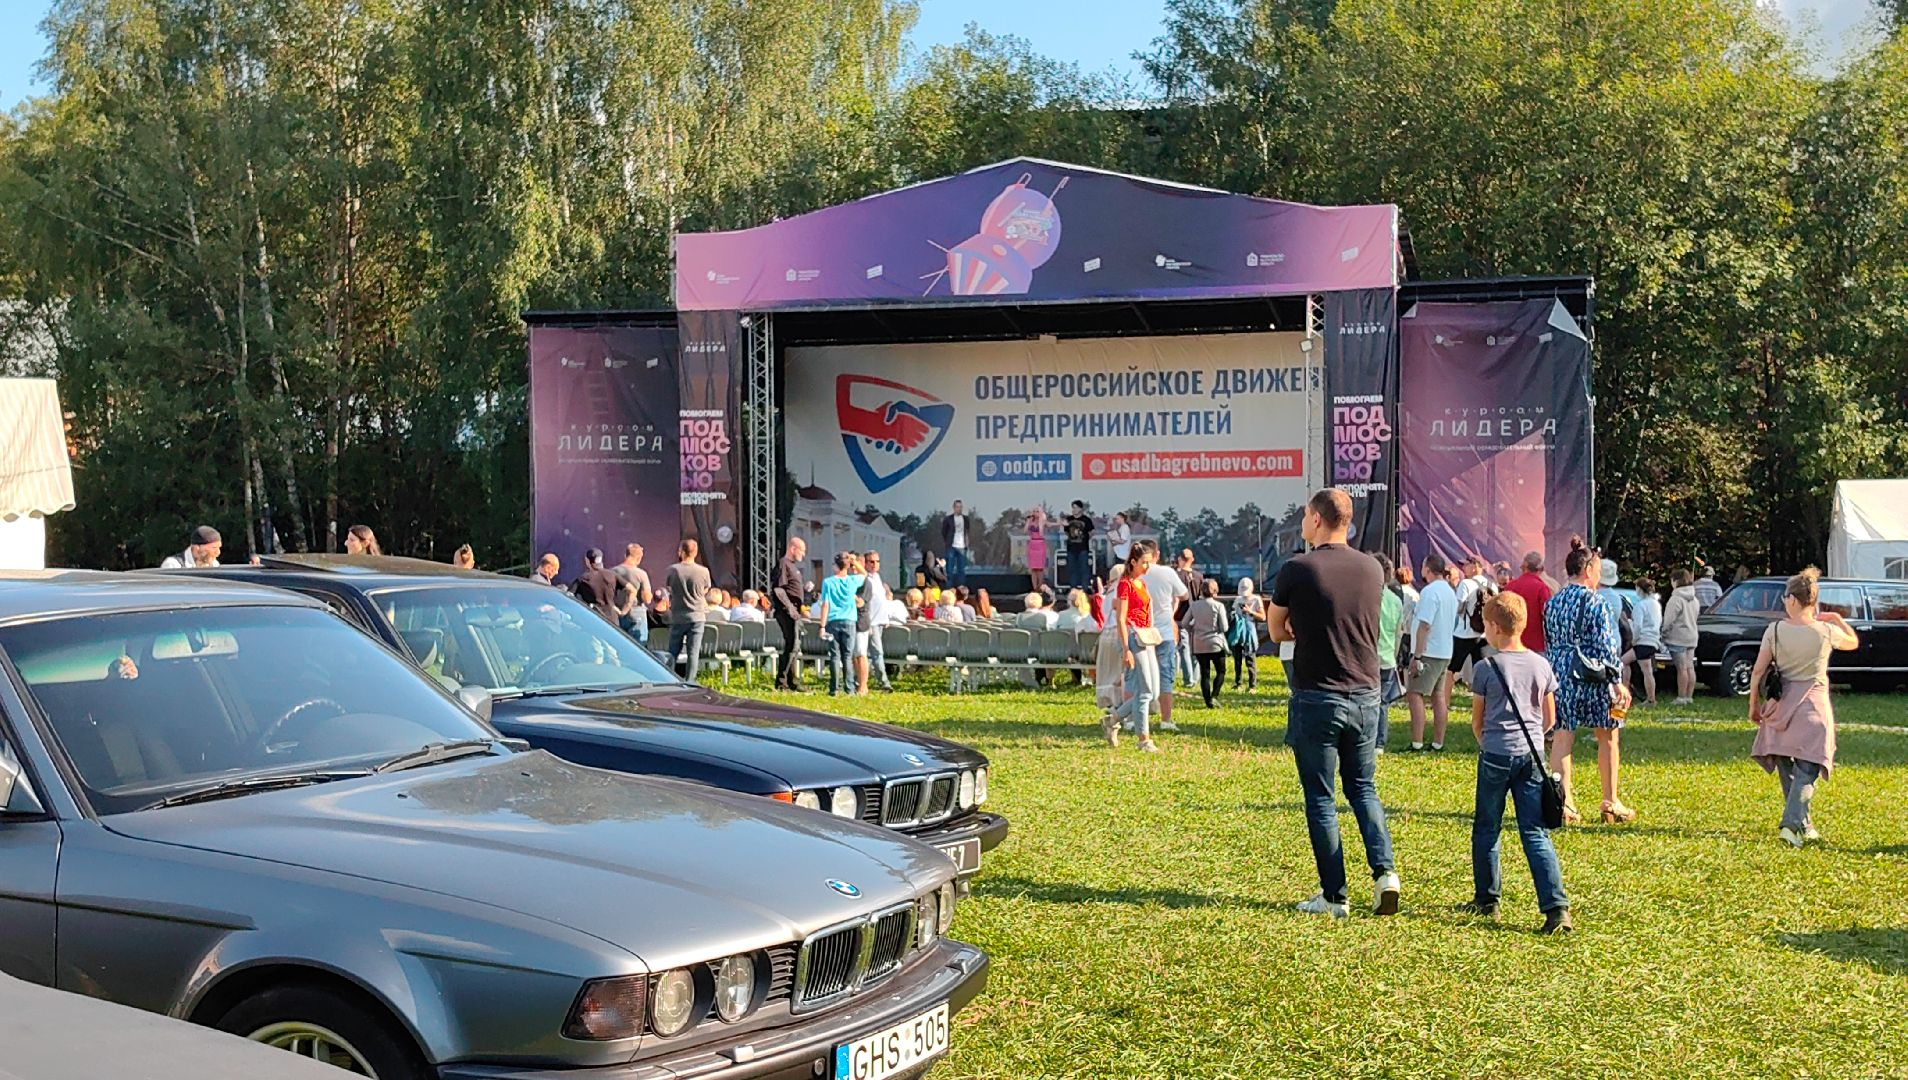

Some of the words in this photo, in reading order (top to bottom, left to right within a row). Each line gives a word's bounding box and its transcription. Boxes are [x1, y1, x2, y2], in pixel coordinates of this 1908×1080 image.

[1340, 325, 1385, 334] ЛИДЕРА
[975, 365, 1203, 403] ОБЩЕРОССИЙСКОЕ
[976, 405, 1232, 443] ПРЕДПРИНИМАТЕЛЕЙ
[1334, 405, 1385, 426] ПОД
[680, 420, 725, 438] ПОД
[1334, 425, 1392, 442] МОС
[1430, 419, 1556, 436] ЛИДЕРА
[558, 435, 662, 451] ЛИДЕРА
[680, 437, 731, 454] МОС
[1334, 443, 1381, 460] КОВ
[680, 455, 721, 471] КОВ
[1003, 457, 1066, 476] oodp.ru
[1111, 453, 1293, 475] usadbagrebnevo.com
[1335, 461, 1372, 479] ЬЮ
[681, 472, 713, 488] ЬЮ
[854, 1032, 900, 1080] GHS
[914, 1010, 945, 1057] 505
